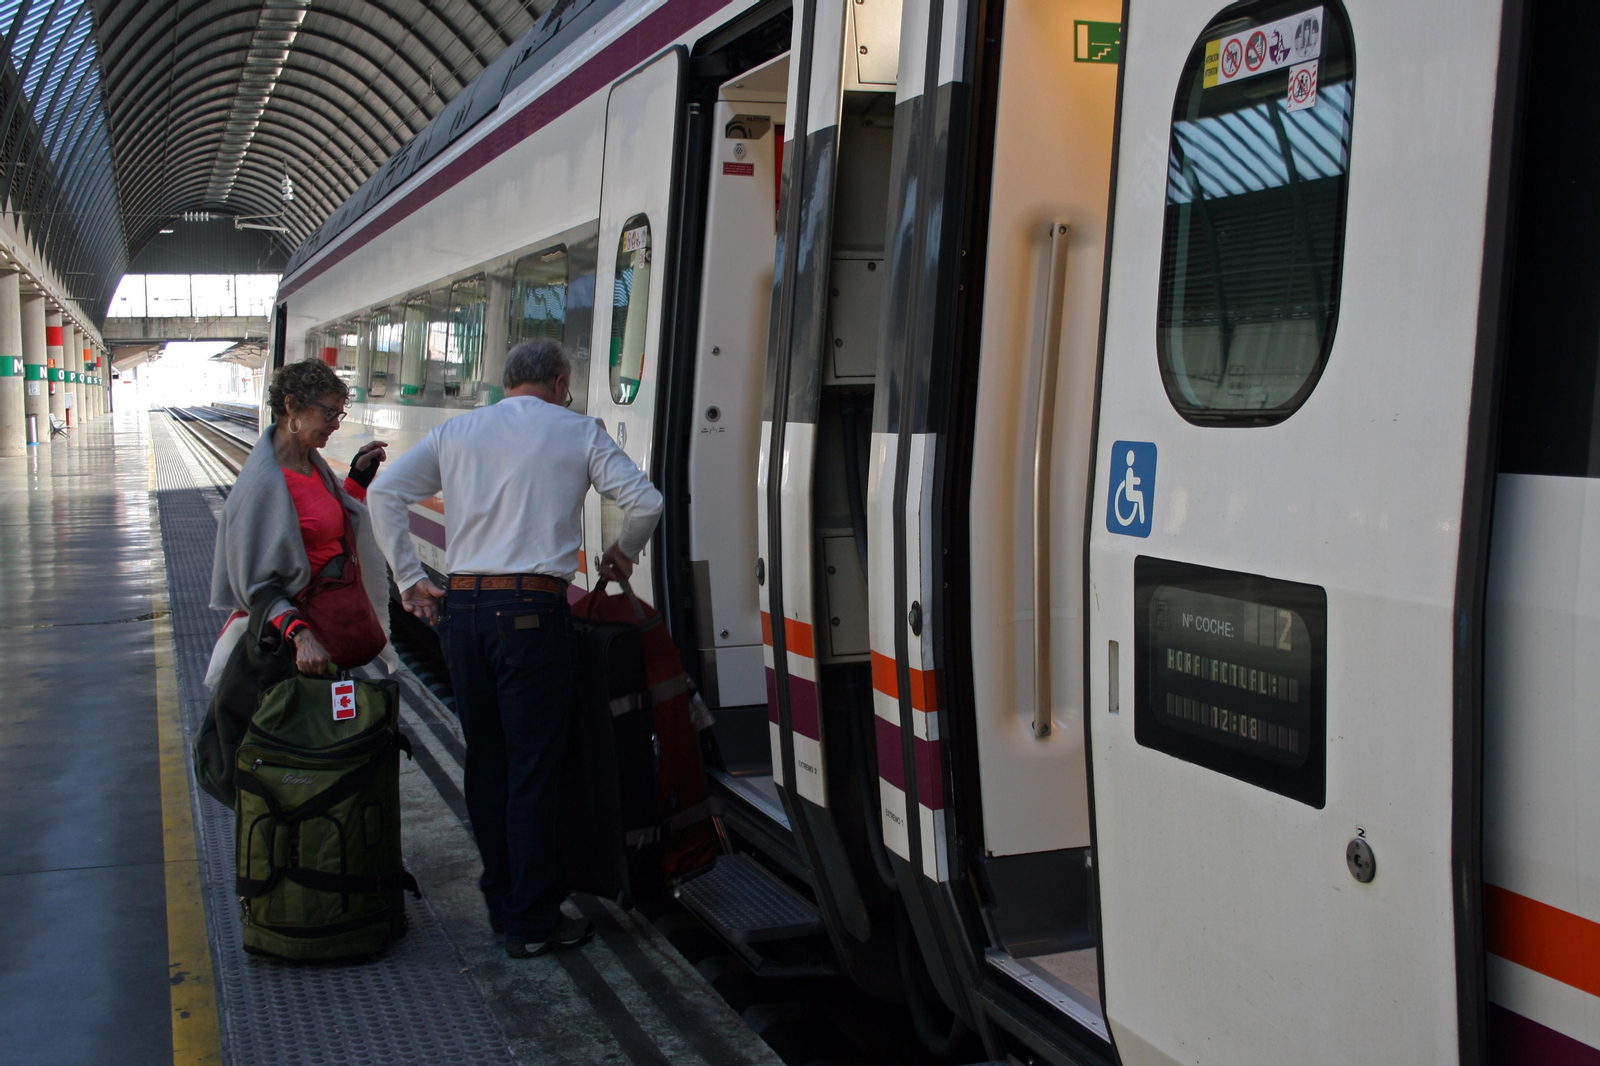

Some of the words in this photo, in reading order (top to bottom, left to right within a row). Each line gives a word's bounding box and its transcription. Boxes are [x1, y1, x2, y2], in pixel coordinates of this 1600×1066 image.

[14, 359, 24, 373] M
[40, 367, 47, 378] N
[58, 370, 65, 380] O
[70, 373, 76, 381] P
[79, 374, 85, 383] Q
[87, 376, 92, 384] R
[1195, 615, 1234, 638] COCHE:
[1279, 610, 1292, 651] 2
[1167, 648, 1200, 676] HORA
[1211, 659, 1277, 694] ACTUAL:
[1212, 706, 1258, 741] 12:08
[798, 760, 814, 774] EXTREMO
[885, 808, 901, 825] EXTREMO
[1357, 827, 1366, 838] 2
